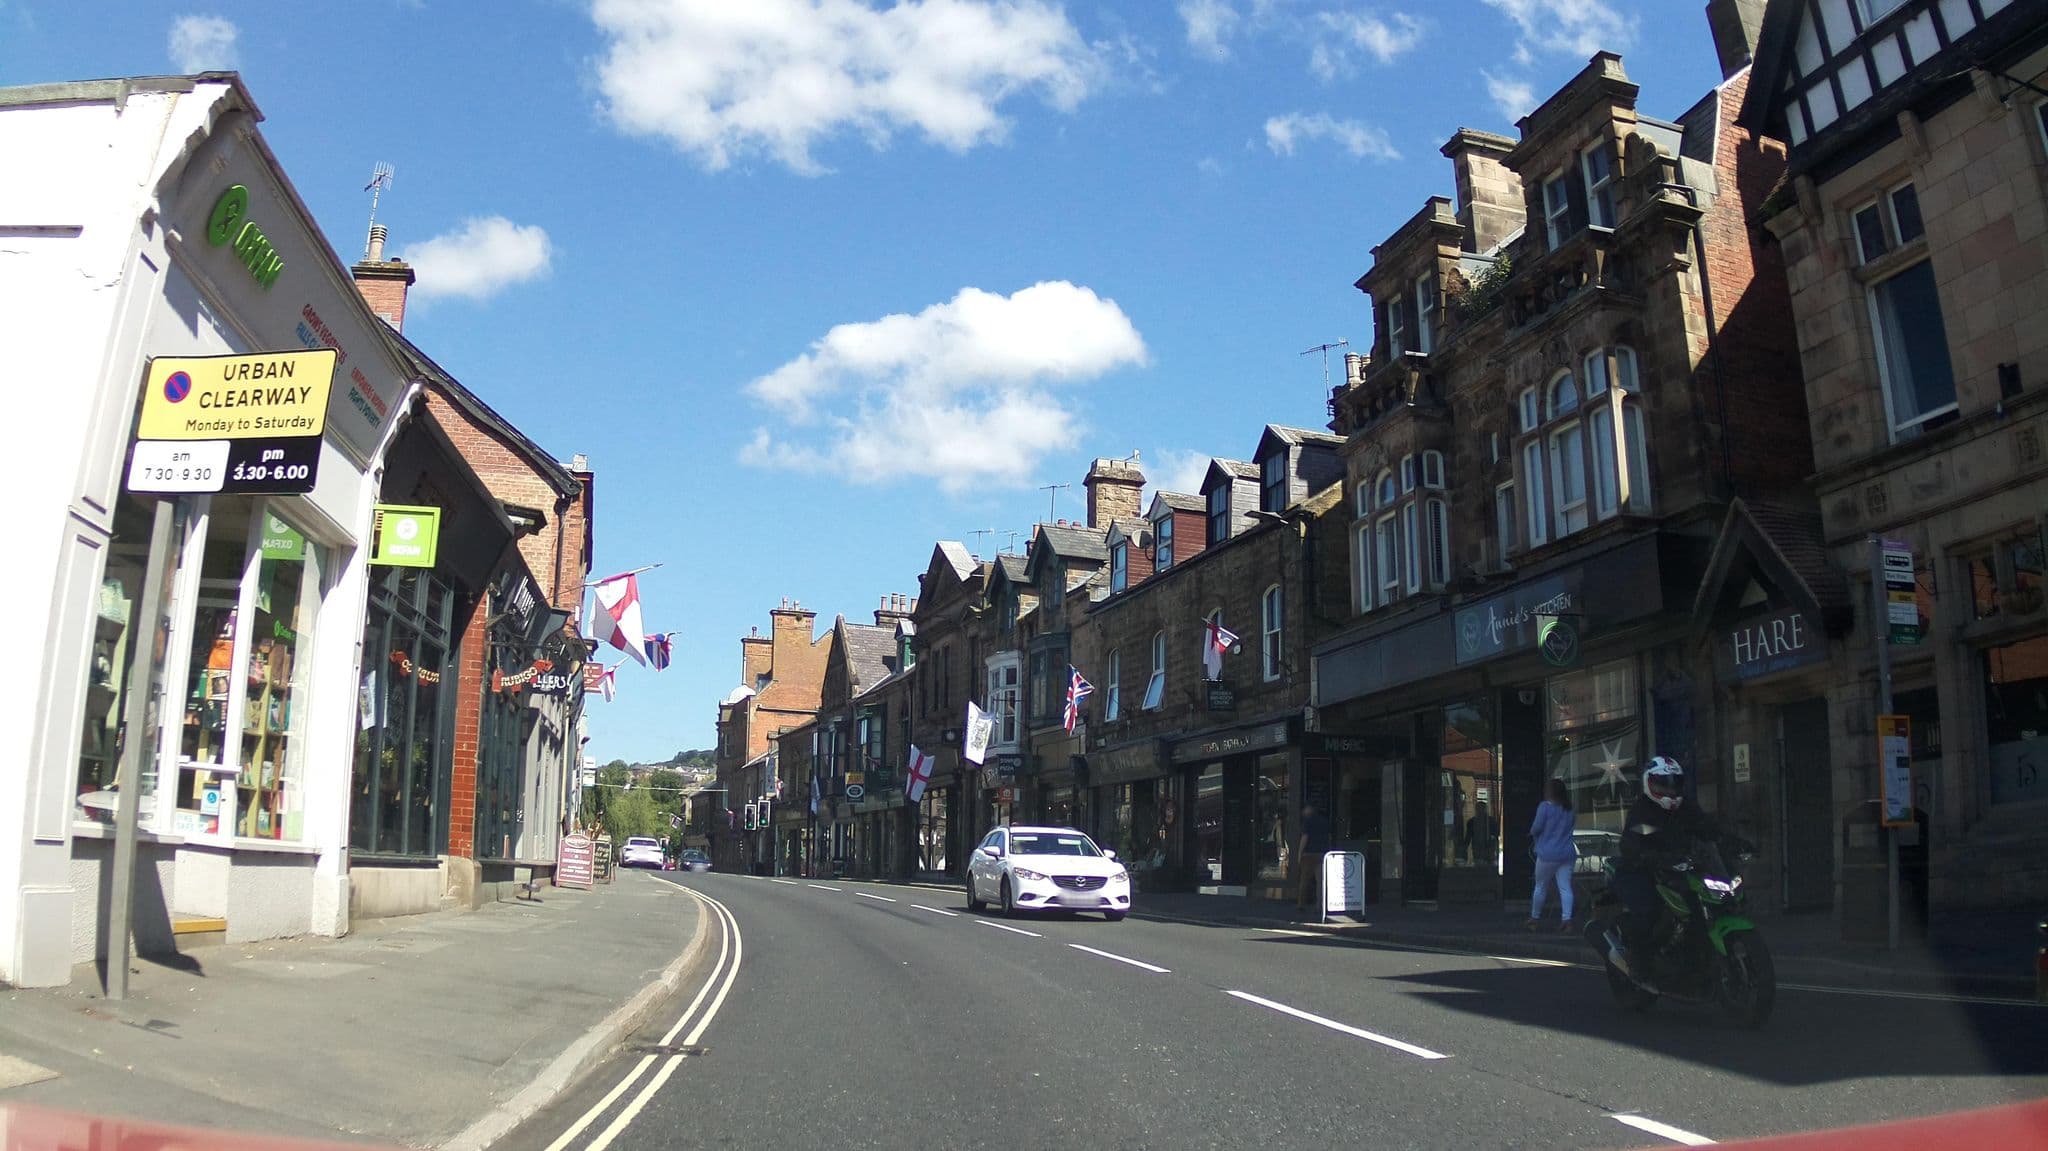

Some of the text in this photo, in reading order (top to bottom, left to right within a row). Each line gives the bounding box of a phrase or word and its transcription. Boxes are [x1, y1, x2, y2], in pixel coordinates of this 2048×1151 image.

[223, 361, 296, 382] URBAN
[199, 386, 312, 409] CLEARWAY
[185, 415, 315, 433] Monday to Saturday
[172, 452, 191, 462] am
[261, 449, 285, 463] pm
[232, 464, 309, 481] 3.30-6.00
[1485, 605, 1528, 645] Annie's
[1732, 613, 1804, 665] HARE
[501, 667, 538, 687] RUBIGO
